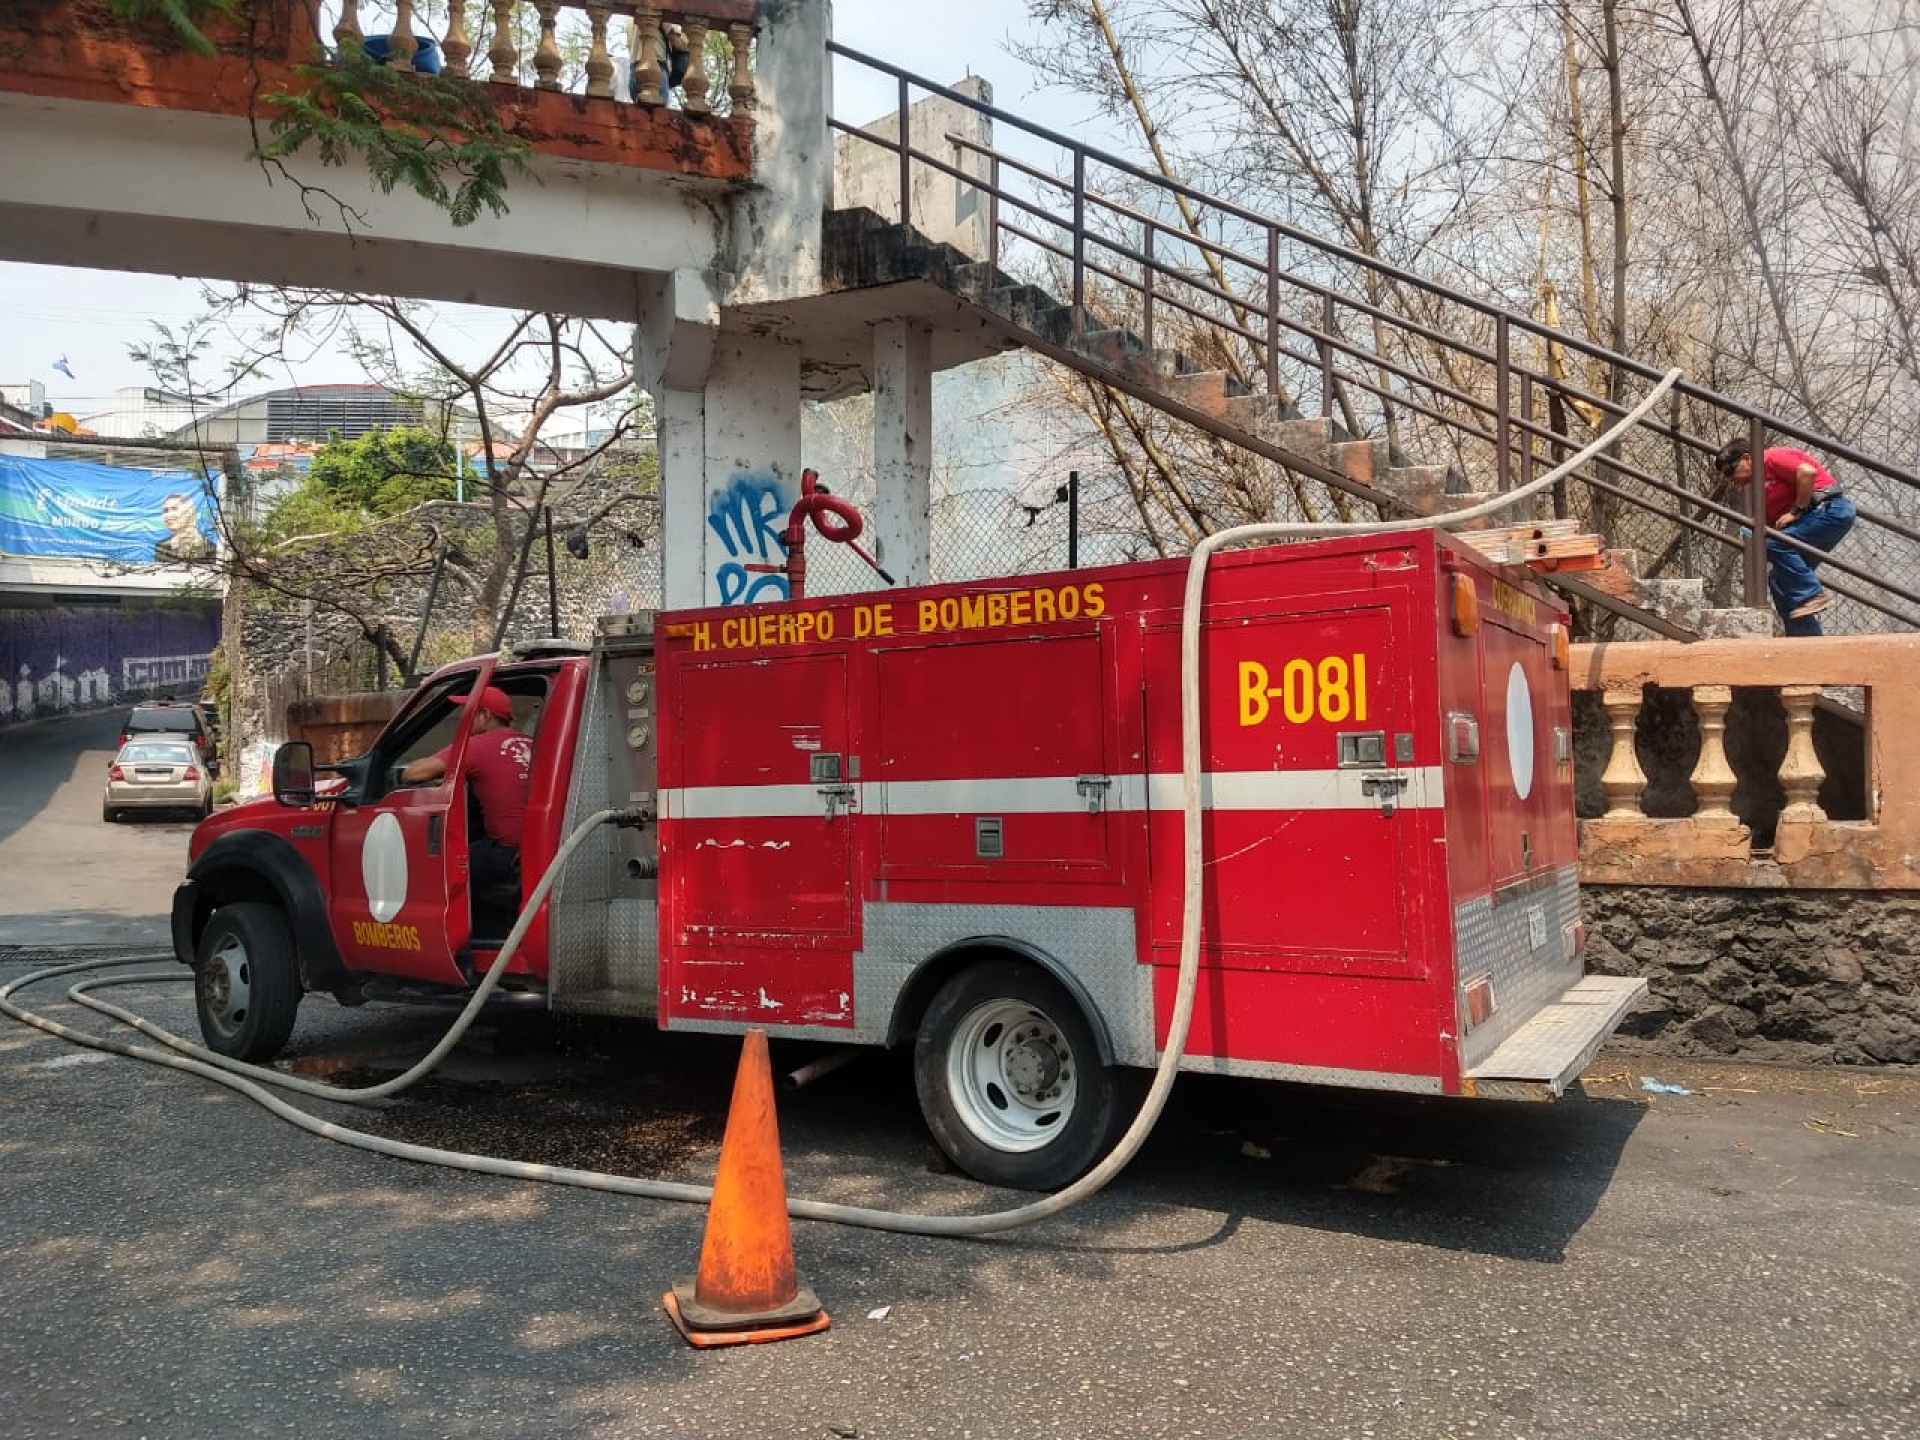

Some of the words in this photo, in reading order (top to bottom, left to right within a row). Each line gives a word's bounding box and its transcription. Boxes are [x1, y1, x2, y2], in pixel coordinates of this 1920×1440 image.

[694, 622, 717, 652] H.
[722, 610, 834, 649] CUERPO
[854, 603, 894, 639] DE
[918, 583, 1105, 633] BOMBEROS
[1239, 653, 1367, 727] B-081
[353, 920, 421, 951] BOMBEROS
